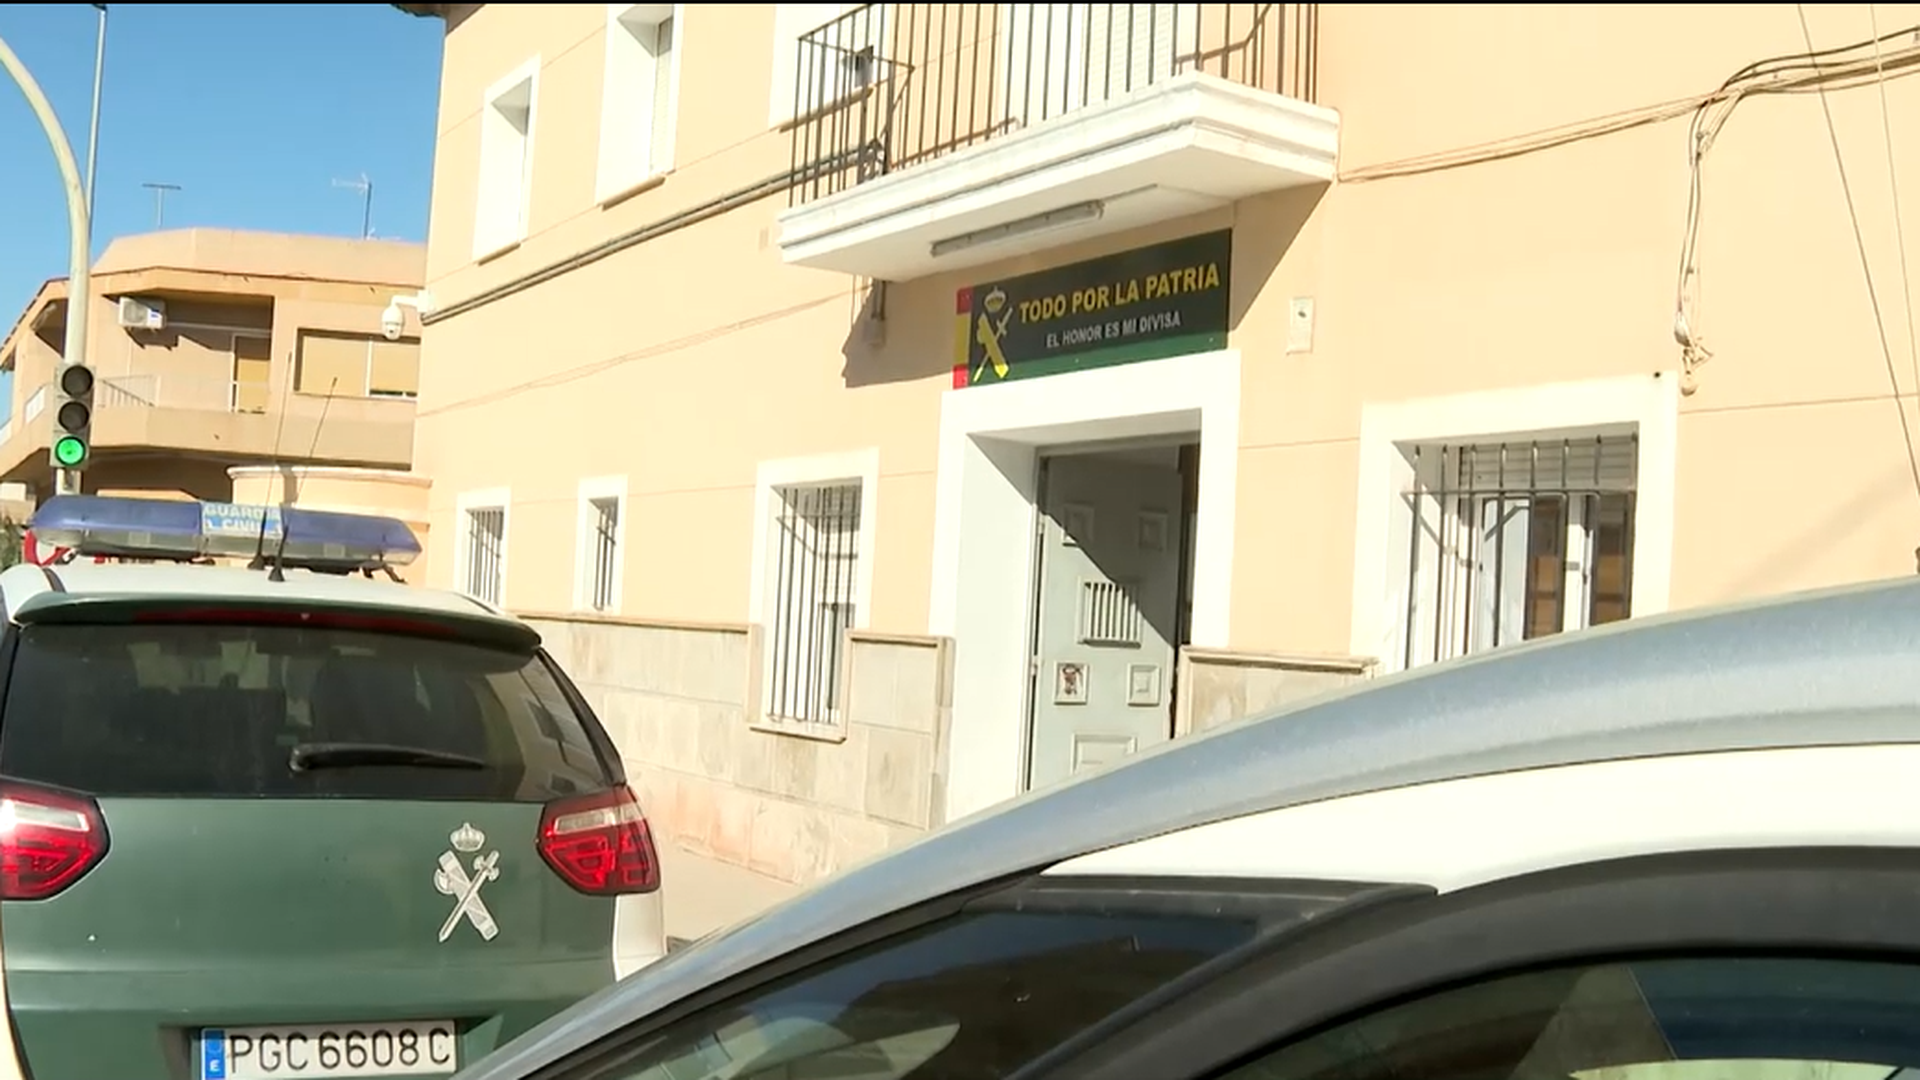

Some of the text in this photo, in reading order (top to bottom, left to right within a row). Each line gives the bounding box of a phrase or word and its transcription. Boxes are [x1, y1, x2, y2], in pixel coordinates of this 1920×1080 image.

[1019, 262, 1219, 324] TODO POR LA PATRIA
[1046, 310, 1181, 349] EL HONOR ES MI DIVISA
[210, 1060, 220, 1072] E
